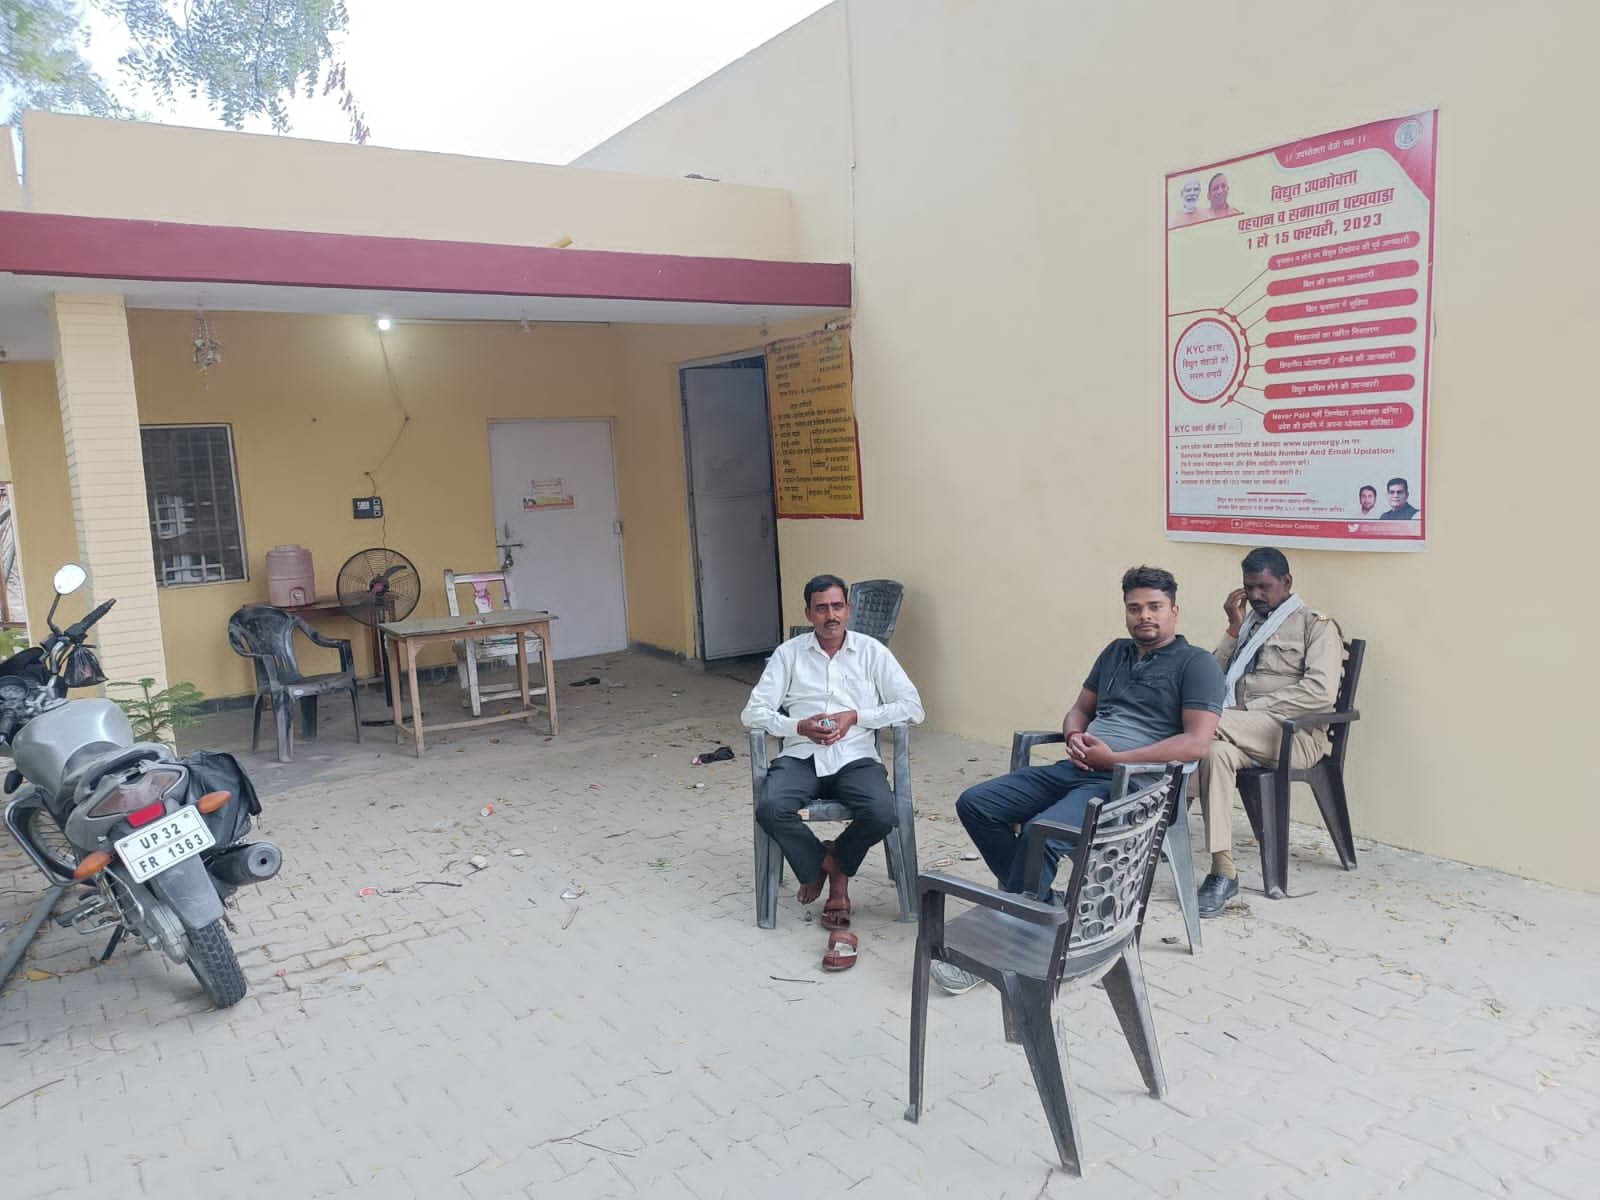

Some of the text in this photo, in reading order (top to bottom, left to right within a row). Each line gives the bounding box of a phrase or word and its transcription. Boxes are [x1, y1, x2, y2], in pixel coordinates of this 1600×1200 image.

[1271, 170, 1358, 202] विद्युत उपभोक्ता
[1237, 213, 1274, 231] पहचान
[1278, 211, 1285, 223] व
[1288, 199, 1339, 221] समाधान
[1257, 233, 1268, 248] से
[1275, 232, 1289, 244] 15
[1293, 219, 1338, 240] फरवरी,
[1343, 213, 1382, 232] 2023
[1186, 344, 1205, 355] KYC
[1174, 424, 1190, 433] KYC
[1278, 449, 1308, 457] Number
[1310, 448, 1326, 456] And
[1353, 447, 1395, 456] Updation
[140, 823, 181, 849] UP 32
[139, 834, 204, 873] FR 1363
